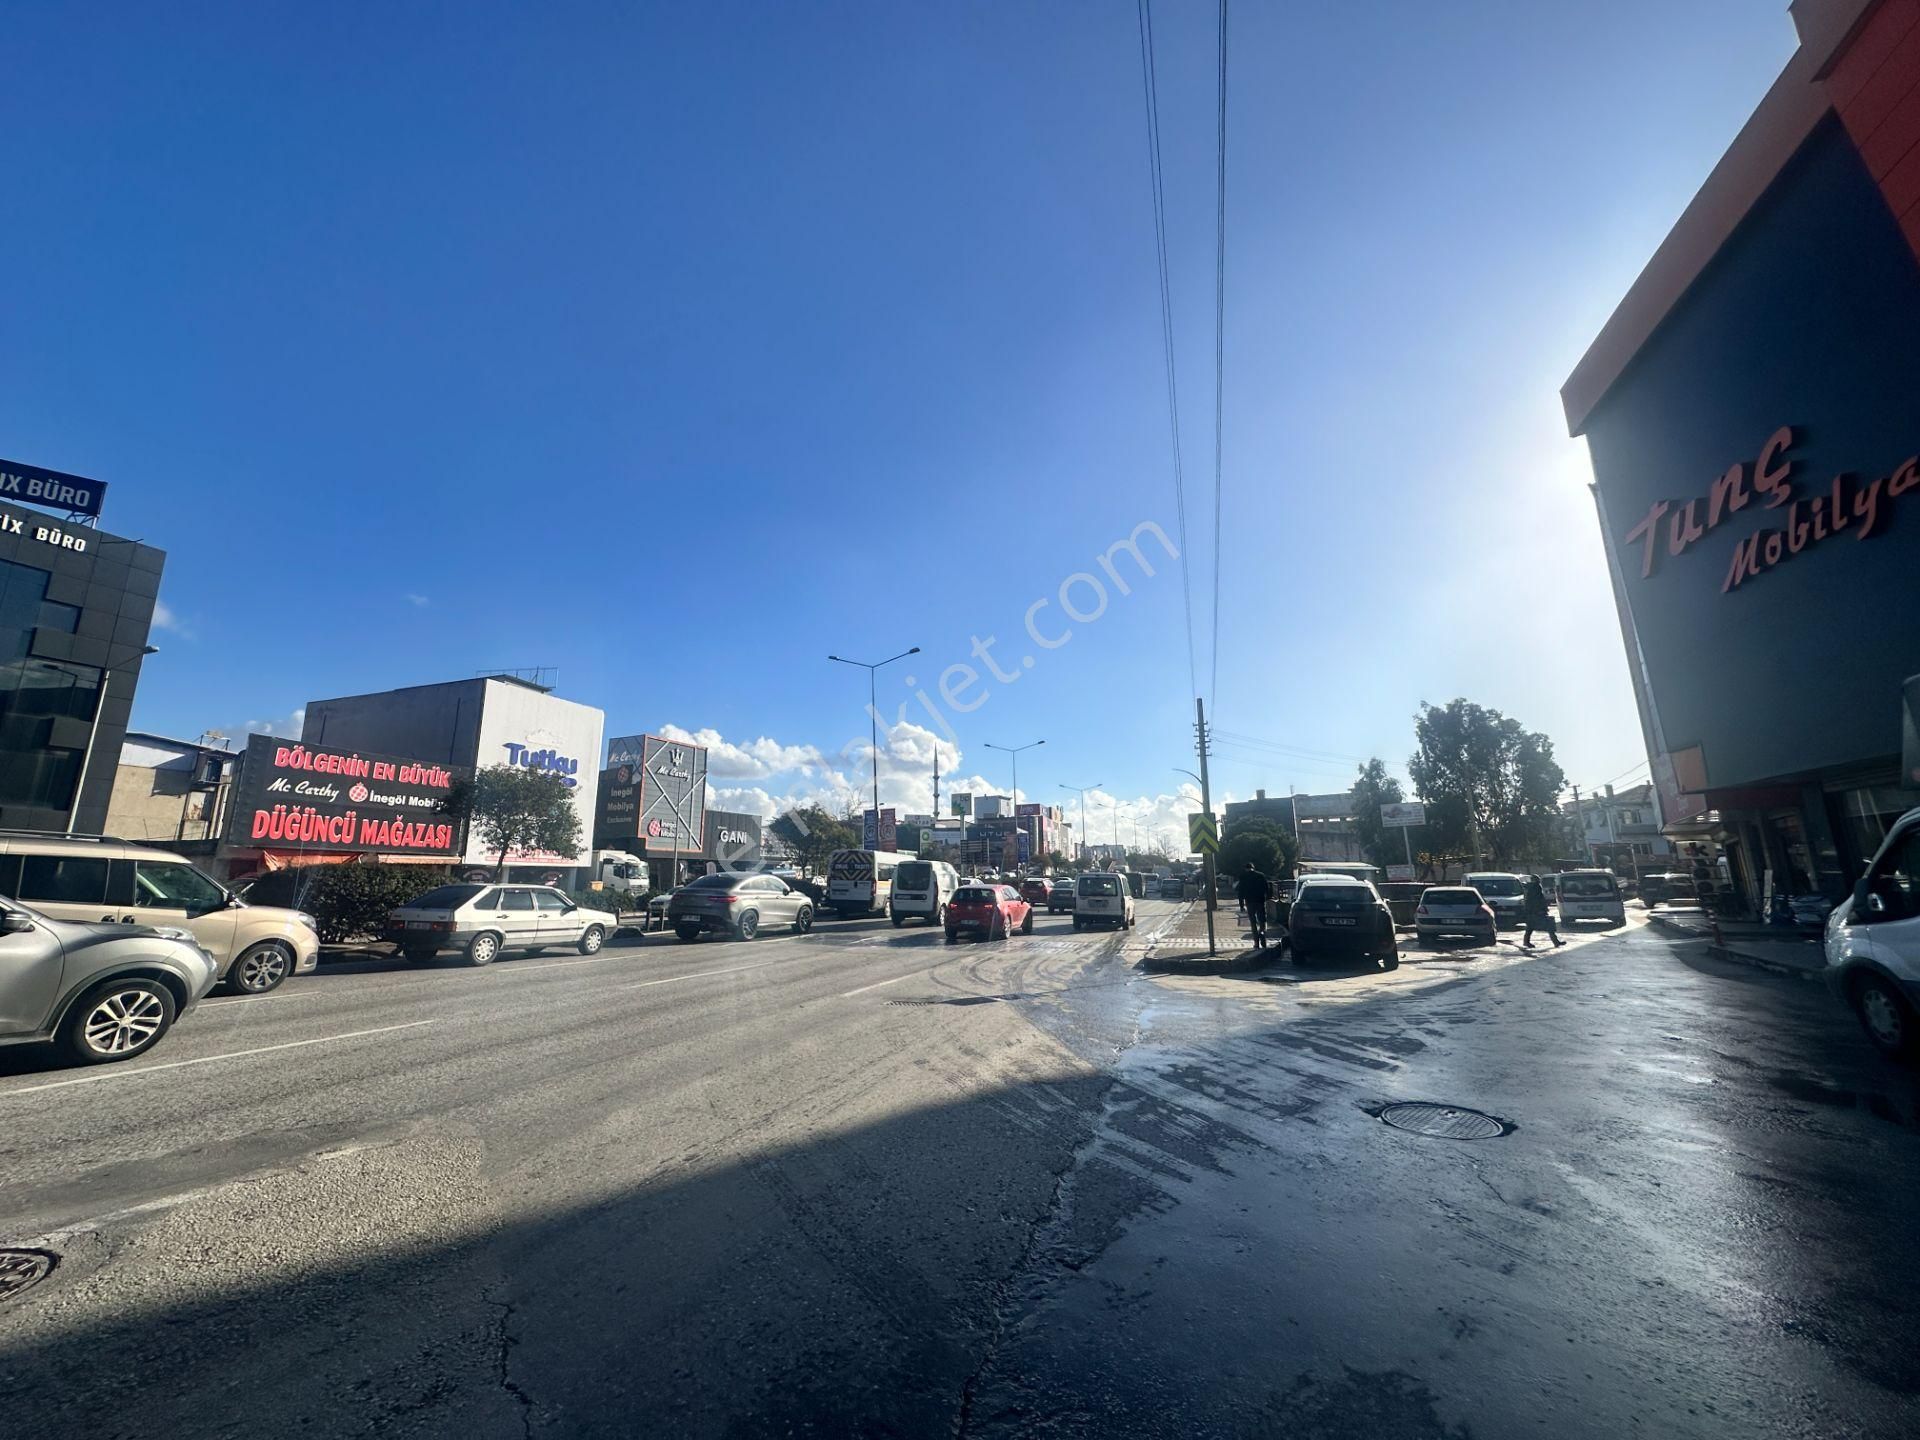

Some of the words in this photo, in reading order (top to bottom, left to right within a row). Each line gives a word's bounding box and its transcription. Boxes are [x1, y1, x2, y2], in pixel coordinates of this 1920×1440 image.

[26, 478, 90, 507] BÜRO
[1624, 426, 1792, 579] Tunç
[36, 527, 87, 552] BÜRO
[1720, 454, 1920, 594] Mobilya
[274, 745, 370, 778] BÖLGENİN
[373, 762, 395, 781] EN
[399, 764, 451, 788] BÜYÜK
[502, 743, 578, 775] Tutku
[267, 778, 291, 793] Mc
[294, 779, 339, 802] Carthy
[369, 790, 405, 806] İnegöl
[252, 805, 356, 844] DÜĞÜNCÜ
[360, 815, 452, 848] MAĞAZASI
